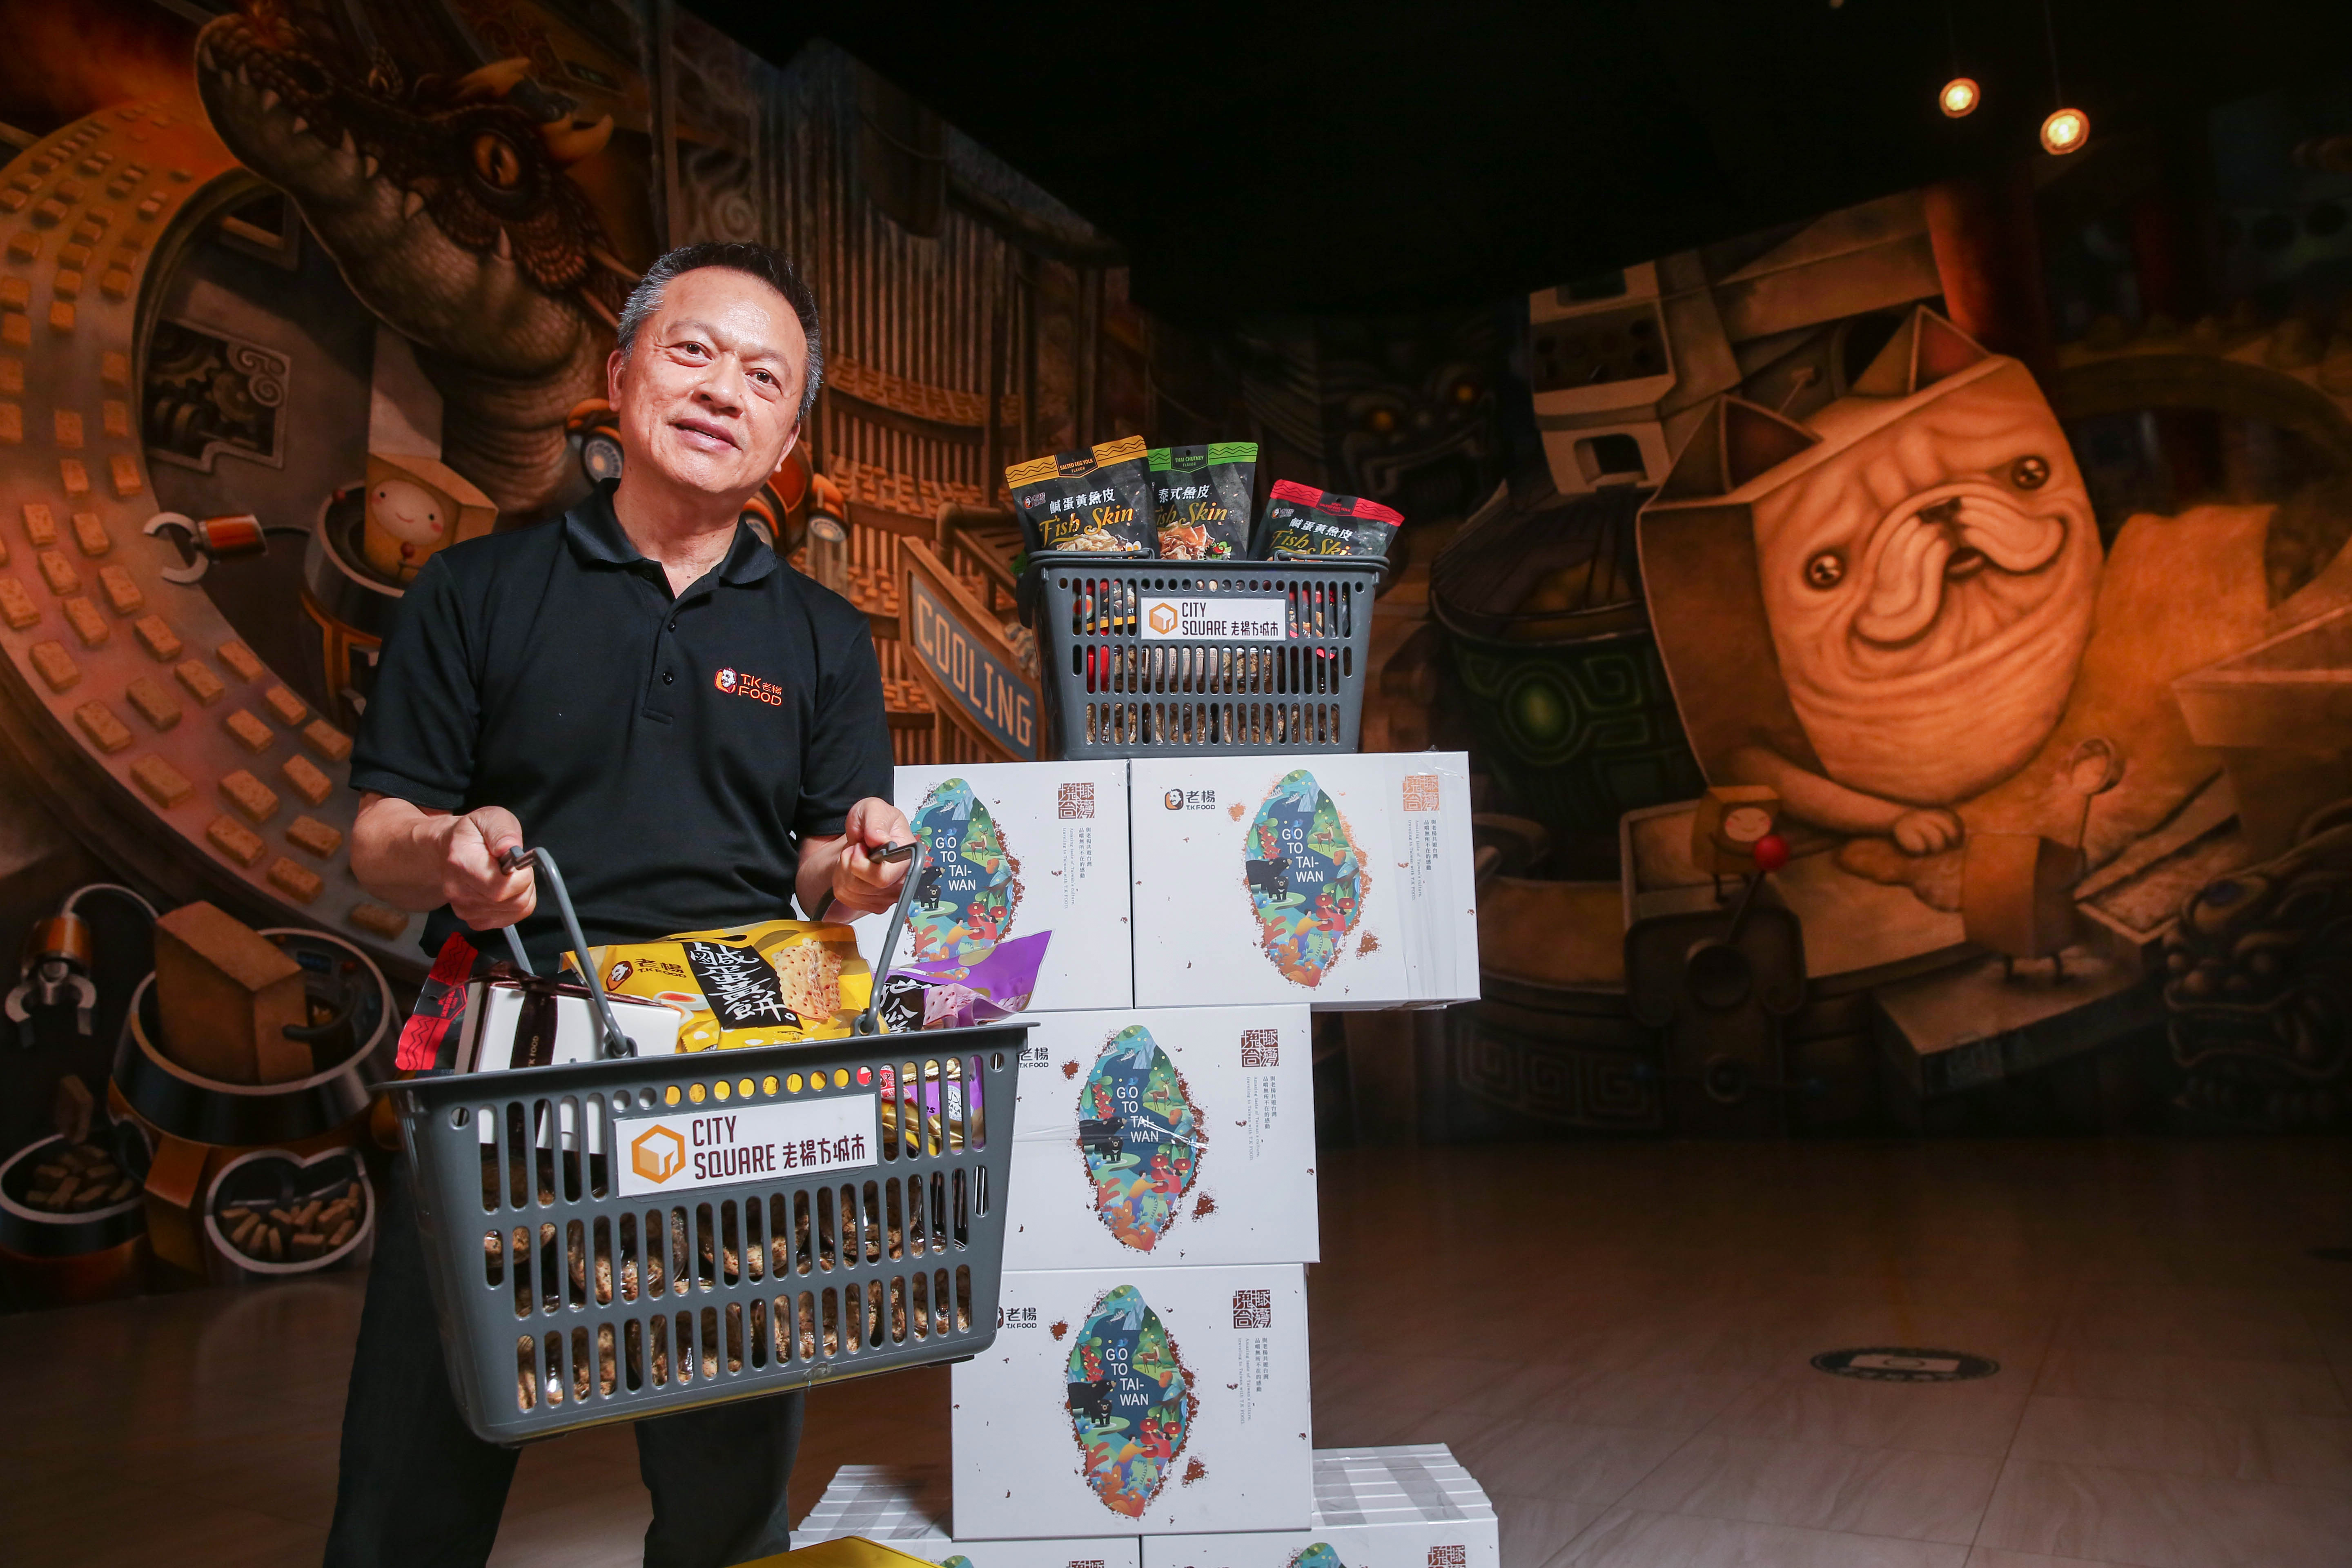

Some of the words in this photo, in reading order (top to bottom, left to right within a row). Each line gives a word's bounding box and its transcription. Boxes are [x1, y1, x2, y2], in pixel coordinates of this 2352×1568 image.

[1158, 485, 1210, 503] 泰式魚皮
[1049, 488, 1116, 514] 鹹蛋黃魚皮
[1156, 504, 1177, 526] ish
[1178, 502, 1228, 528] Skin
[1039, 513, 1080, 548] Fish
[1084, 506, 1133, 535] Skin
[1289, 517, 1353, 541] 鹹蛋黃魚皮
[1269, 529, 1309, 549] Fish
[1306, 539, 1352, 555] Ski
[1182, 602, 1207, 617] CITY
[1182, 621, 1227, 636] SQUARE
[1231, 621, 1278, 637] 老楊方城市
[917, 593, 1032, 747] COOLING
[740, 674, 761, 688] T.K
[762, 682, 782, 695] 老楊
[738, 685, 782, 706] FOOD
[1186, 790, 1215, 803] 老楊
[1282, 829, 1303, 840] GO
[935, 837, 957, 849] GO
[1287, 842, 1303, 854] TO
[940, 851, 957, 863] TO
[1296, 856, 1319, 869] TAI-
[949, 865, 972, 877] TAI-
[1296, 870, 1323, 882] WAN
[949, 879, 976, 891] WAN
[635, 958, 684, 973] 老楊
[655, 969, 686, 978] FOOD
[1116, 1087, 1138, 1099] GO
[1122, 1101, 1138, 1113] TO
[1131, 1115, 1155, 1129] TAI-
[693, 1115, 737, 1147] CITY
[1130, 1130, 1159, 1143] WAN
[694, 1144, 776, 1180] SQUARE
[782, 1134, 865, 1169] 老楊方城市
[1006, 1307, 1037, 1321] 老楊
[1106, 1348, 1127, 1360] GO
[1111, 1363, 1127, 1375] TO
[1120, 1379, 1144, 1391] TAI-
[1120, 1394, 1149, 1406] WAN
